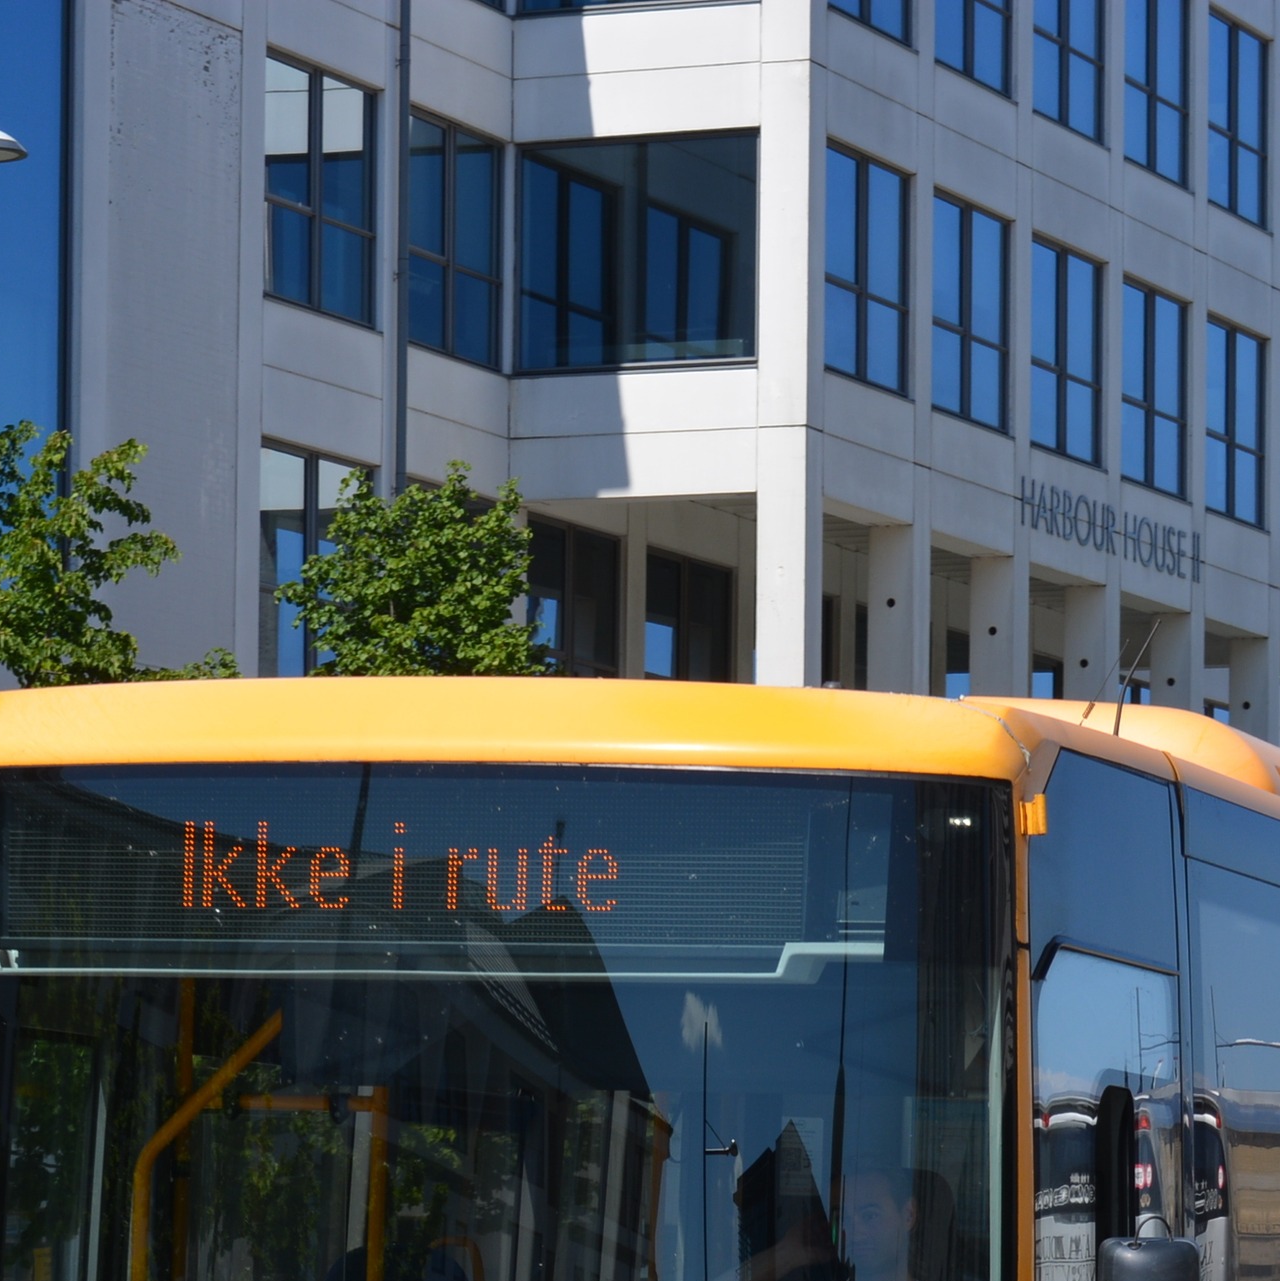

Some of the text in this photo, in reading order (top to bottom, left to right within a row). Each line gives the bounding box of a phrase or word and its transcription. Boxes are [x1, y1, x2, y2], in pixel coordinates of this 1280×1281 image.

[1021, 477, 1201, 583] HARBOUR HOUSE II
[182, 820, 617, 911] Ikke i rute
